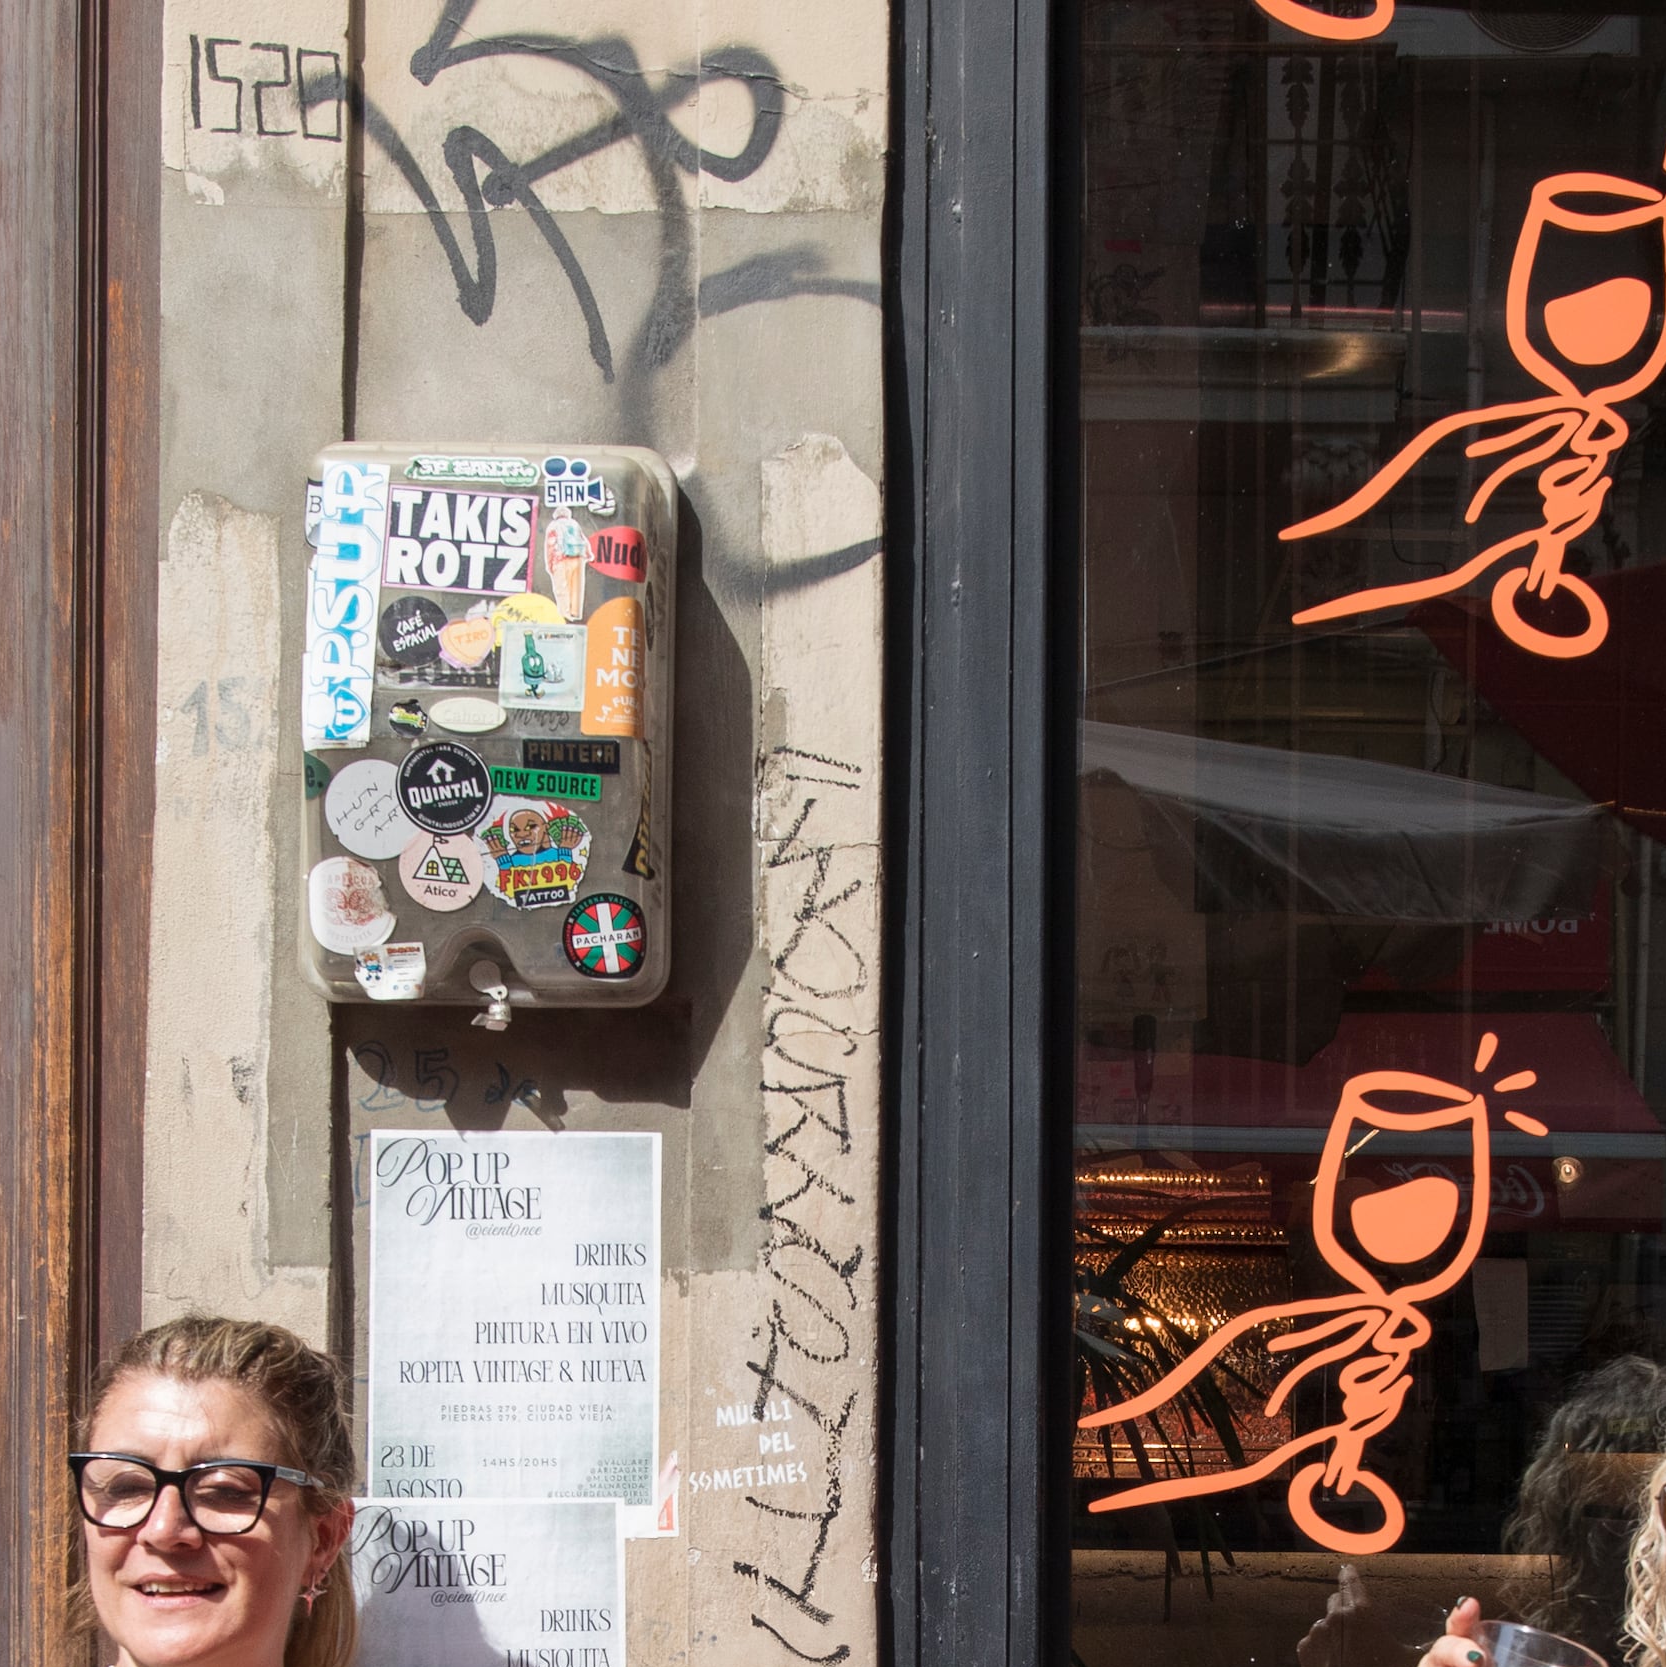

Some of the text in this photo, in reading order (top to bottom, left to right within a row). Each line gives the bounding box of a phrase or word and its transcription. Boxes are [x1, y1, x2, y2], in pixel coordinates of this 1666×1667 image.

[547, 479, 586, 503] STAN
[390, 489, 532, 549] TAKIS
[385, 535, 530, 592] ROTZ
[596, 534, 647, 570] Nud
[396, 608, 424, 636] CAFÉ
[453, 629, 489, 646] TIRO
[595, 668, 642, 689] MO
[526, 742, 616, 765] PANTERA
[407, 777, 484, 810] QUINTAL
[493, 769, 598, 797] NEW SOURCE
[499, 863, 582, 893] FKY996
[519, 889, 565, 906] TATTOO
[571, 895, 635, 918] TABERNA VASCA
[575, 928, 641, 947] PACHARAN
[472, 1152, 511, 1186] UP
[406, 1180, 542, 1227] VINTAGE
[575, 1243, 647, 1267] DRINKS
[540, 1283, 646, 1316] MUSIQUITA
[474, 1321, 648, 1345] PINTURA EN VIVO
[399, 1360, 647, 1384] ROPITA VINTAGE & NUEVA
[440, 1404, 493, 1413] PIEDRAS
[527, 1404, 573, 1413] CIUDAD
[440, 1413, 493, 1422] PIEDRAS
[527, 1413, 573, 1422] CIUDAD
[758, 1431, 796, 1456] DEL
[380, 1445, 437, 1468] 23 DE
[481, 1457, 559, 1468] 14HS/20HS
[380, 1477, 464, 1499] AGOSTO
[688, 1461, 809, 1495] SOMETIMES
[437, 1519, 476, 1552] UP
[371, 1547, 508, 1595] VINTAGE
[540, 1608, 612, 1633] DRINKS
